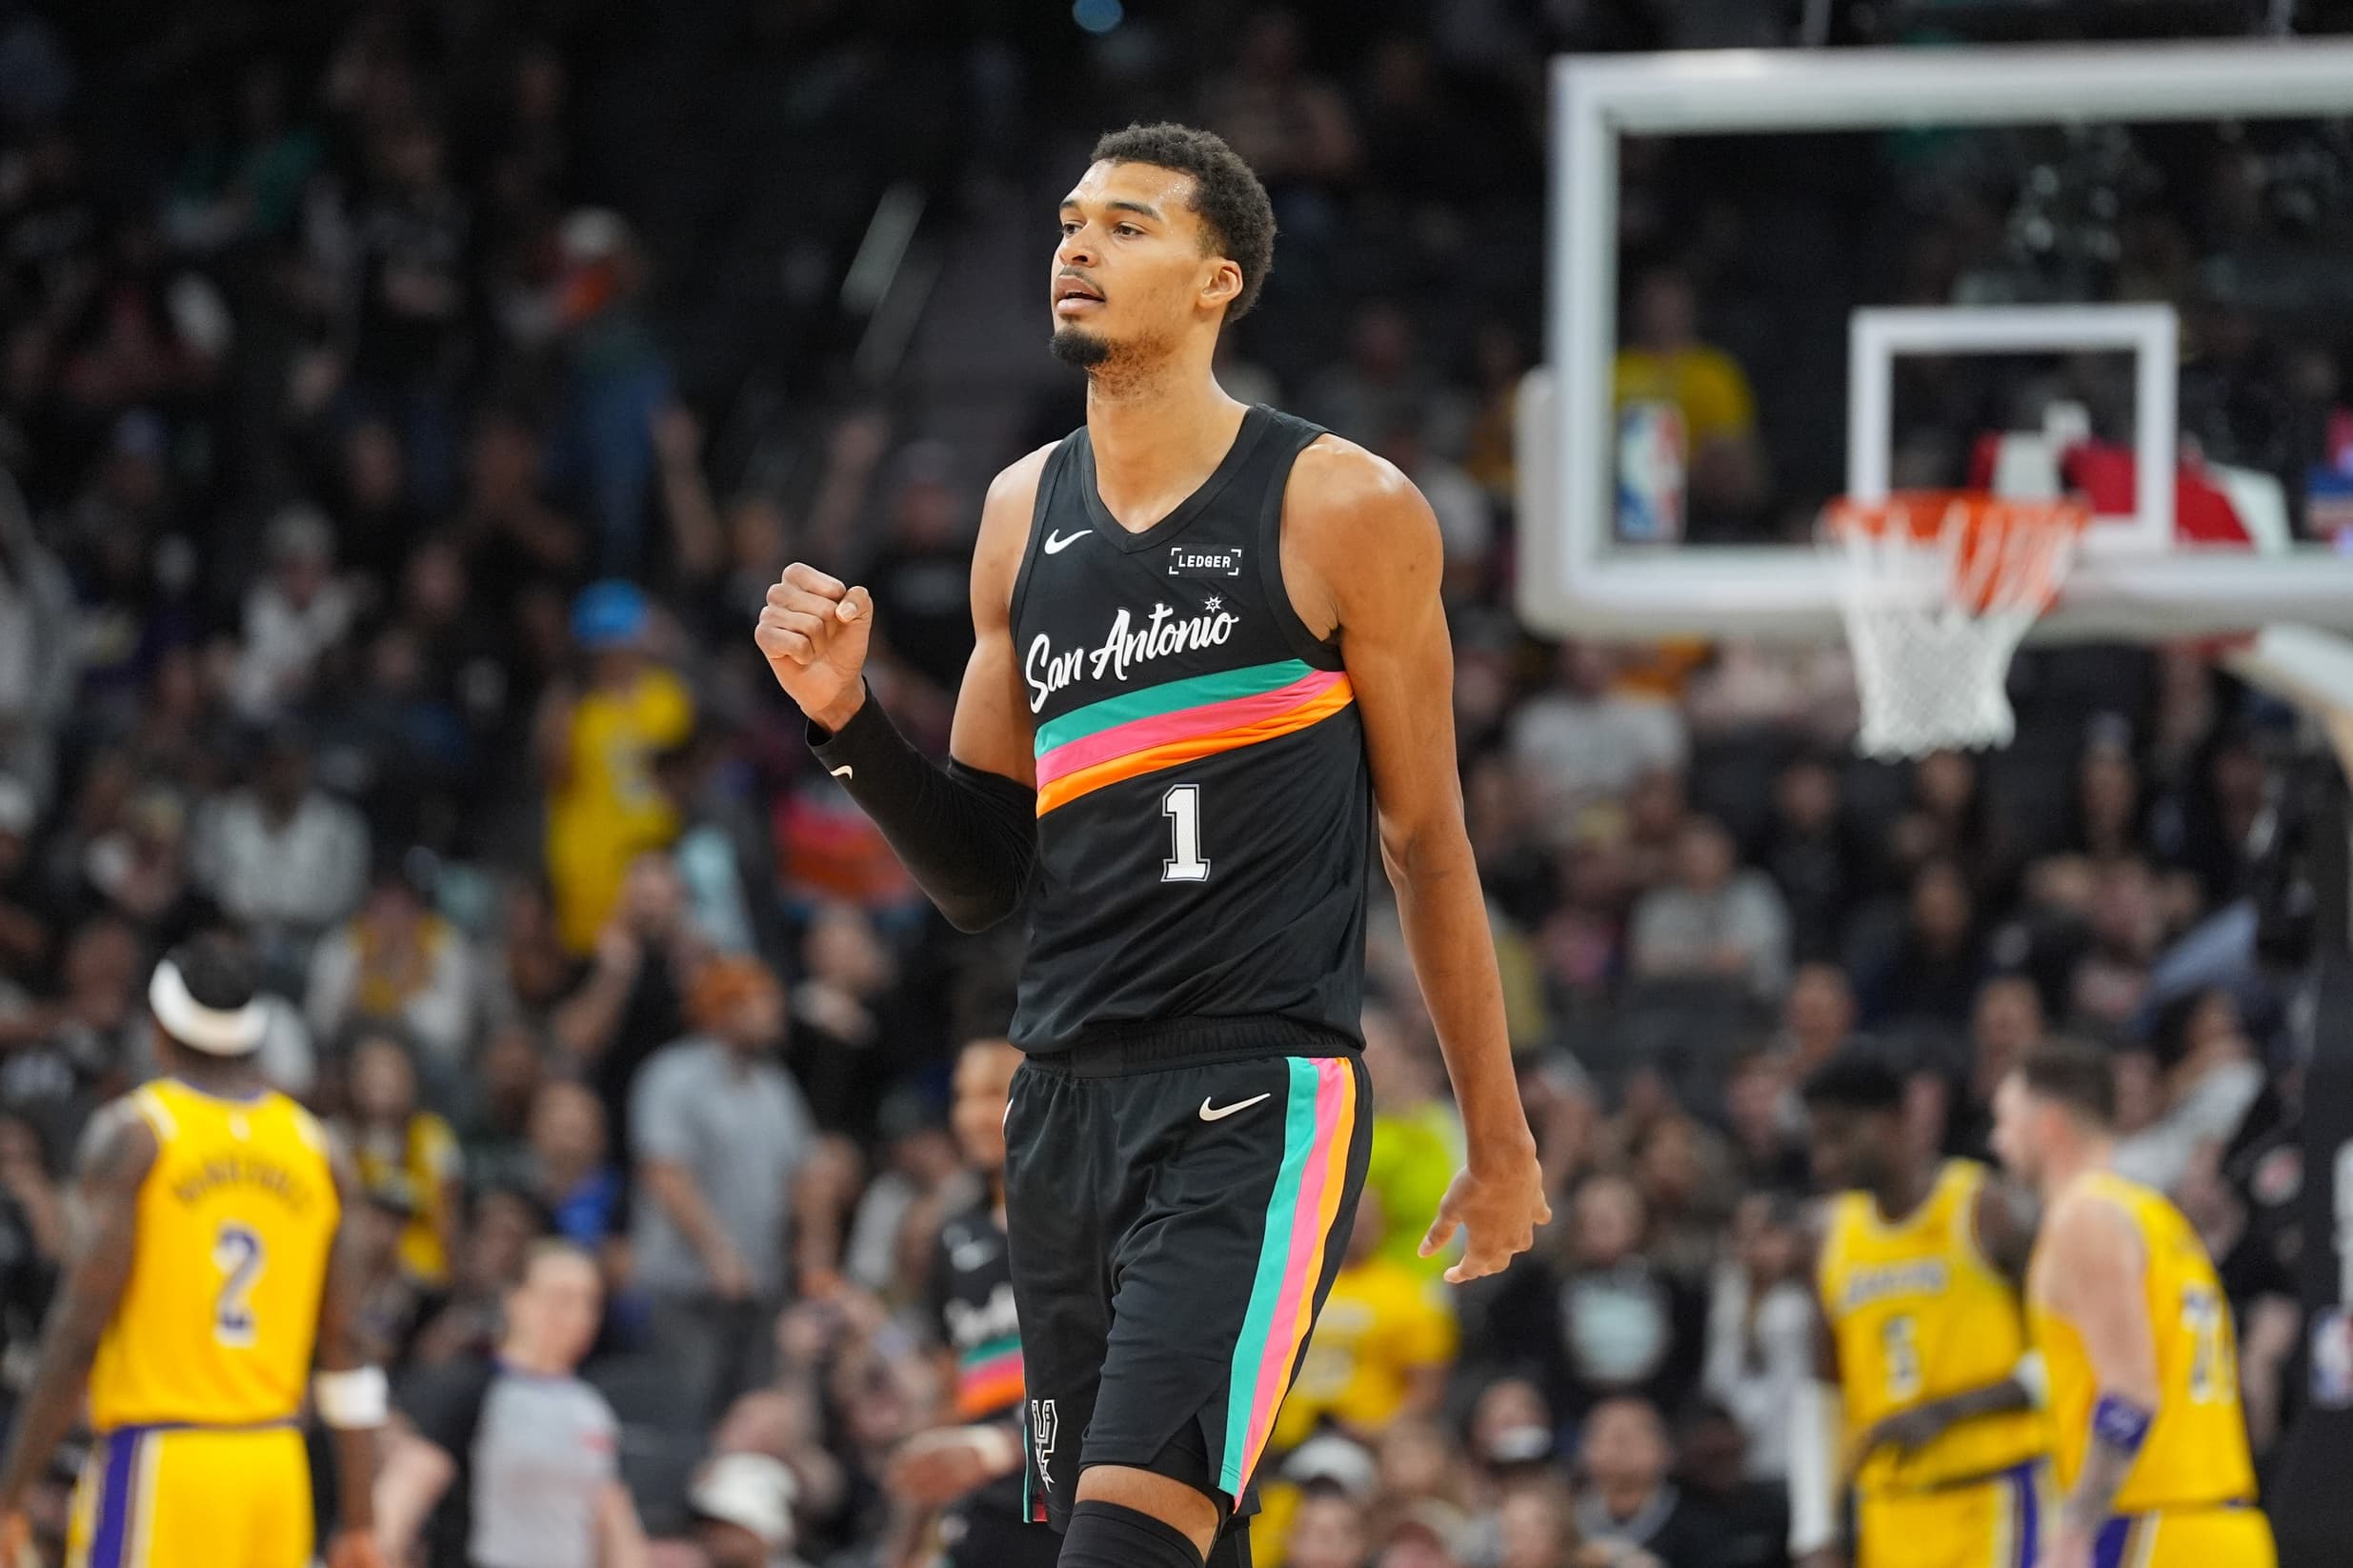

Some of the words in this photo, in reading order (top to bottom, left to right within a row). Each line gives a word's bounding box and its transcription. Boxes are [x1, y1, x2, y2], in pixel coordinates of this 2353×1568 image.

[1177, 554, 1232, 569] LEDGER
[1025, 633, 1085, 714] San
[1089, 597, 1240, 681] Antonio
[1160, 783, 1211, 883] 1
[211, 1218, 266, 1349] 2
